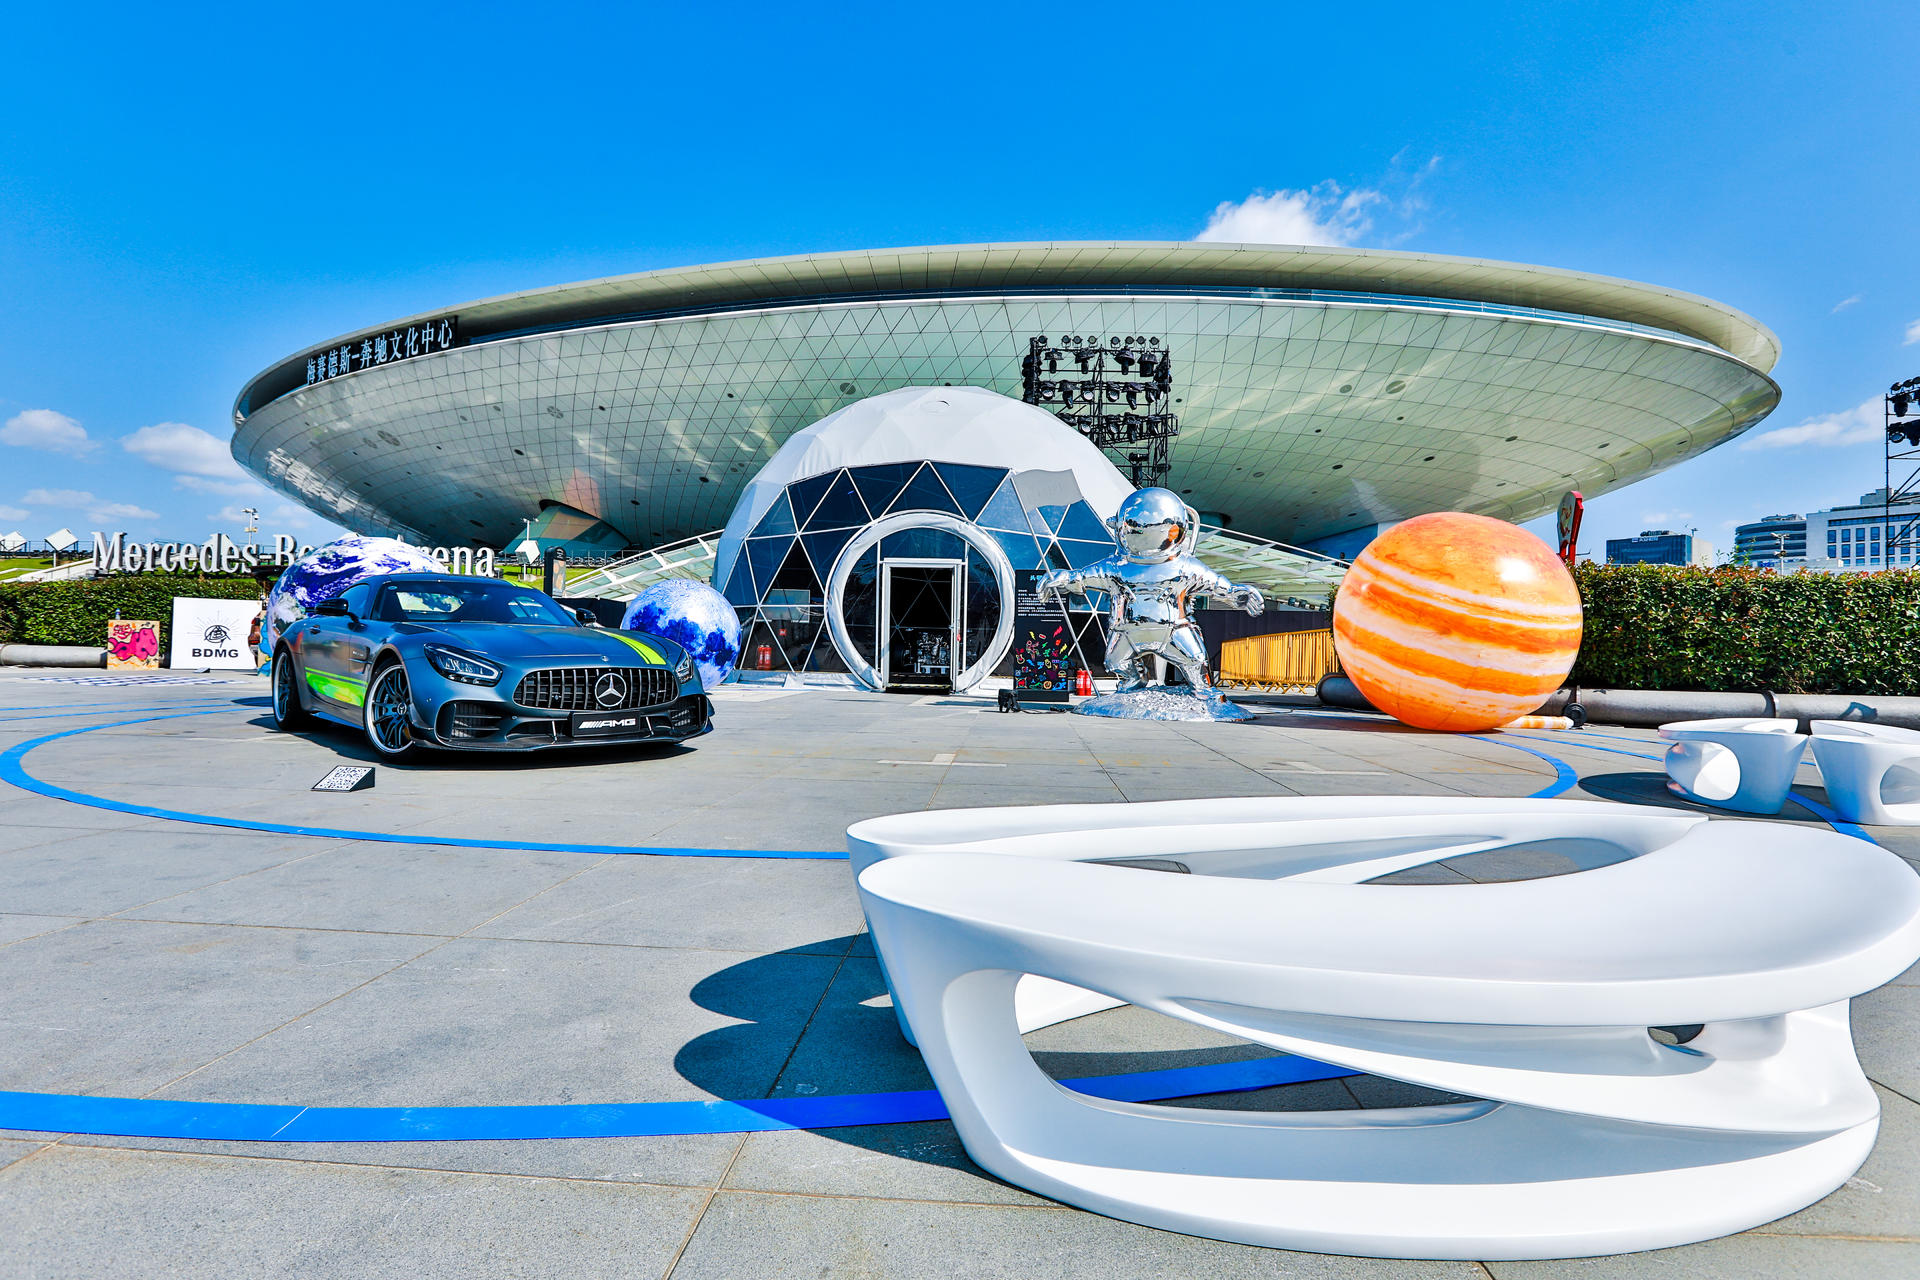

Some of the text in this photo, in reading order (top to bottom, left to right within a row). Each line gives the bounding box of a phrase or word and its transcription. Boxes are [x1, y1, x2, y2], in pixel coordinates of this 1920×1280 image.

[91, 531, 495, 577] Mercedes-B ena
[191, 648, 239, 658] BDMG
[599, 718, 636, 728] AMG
